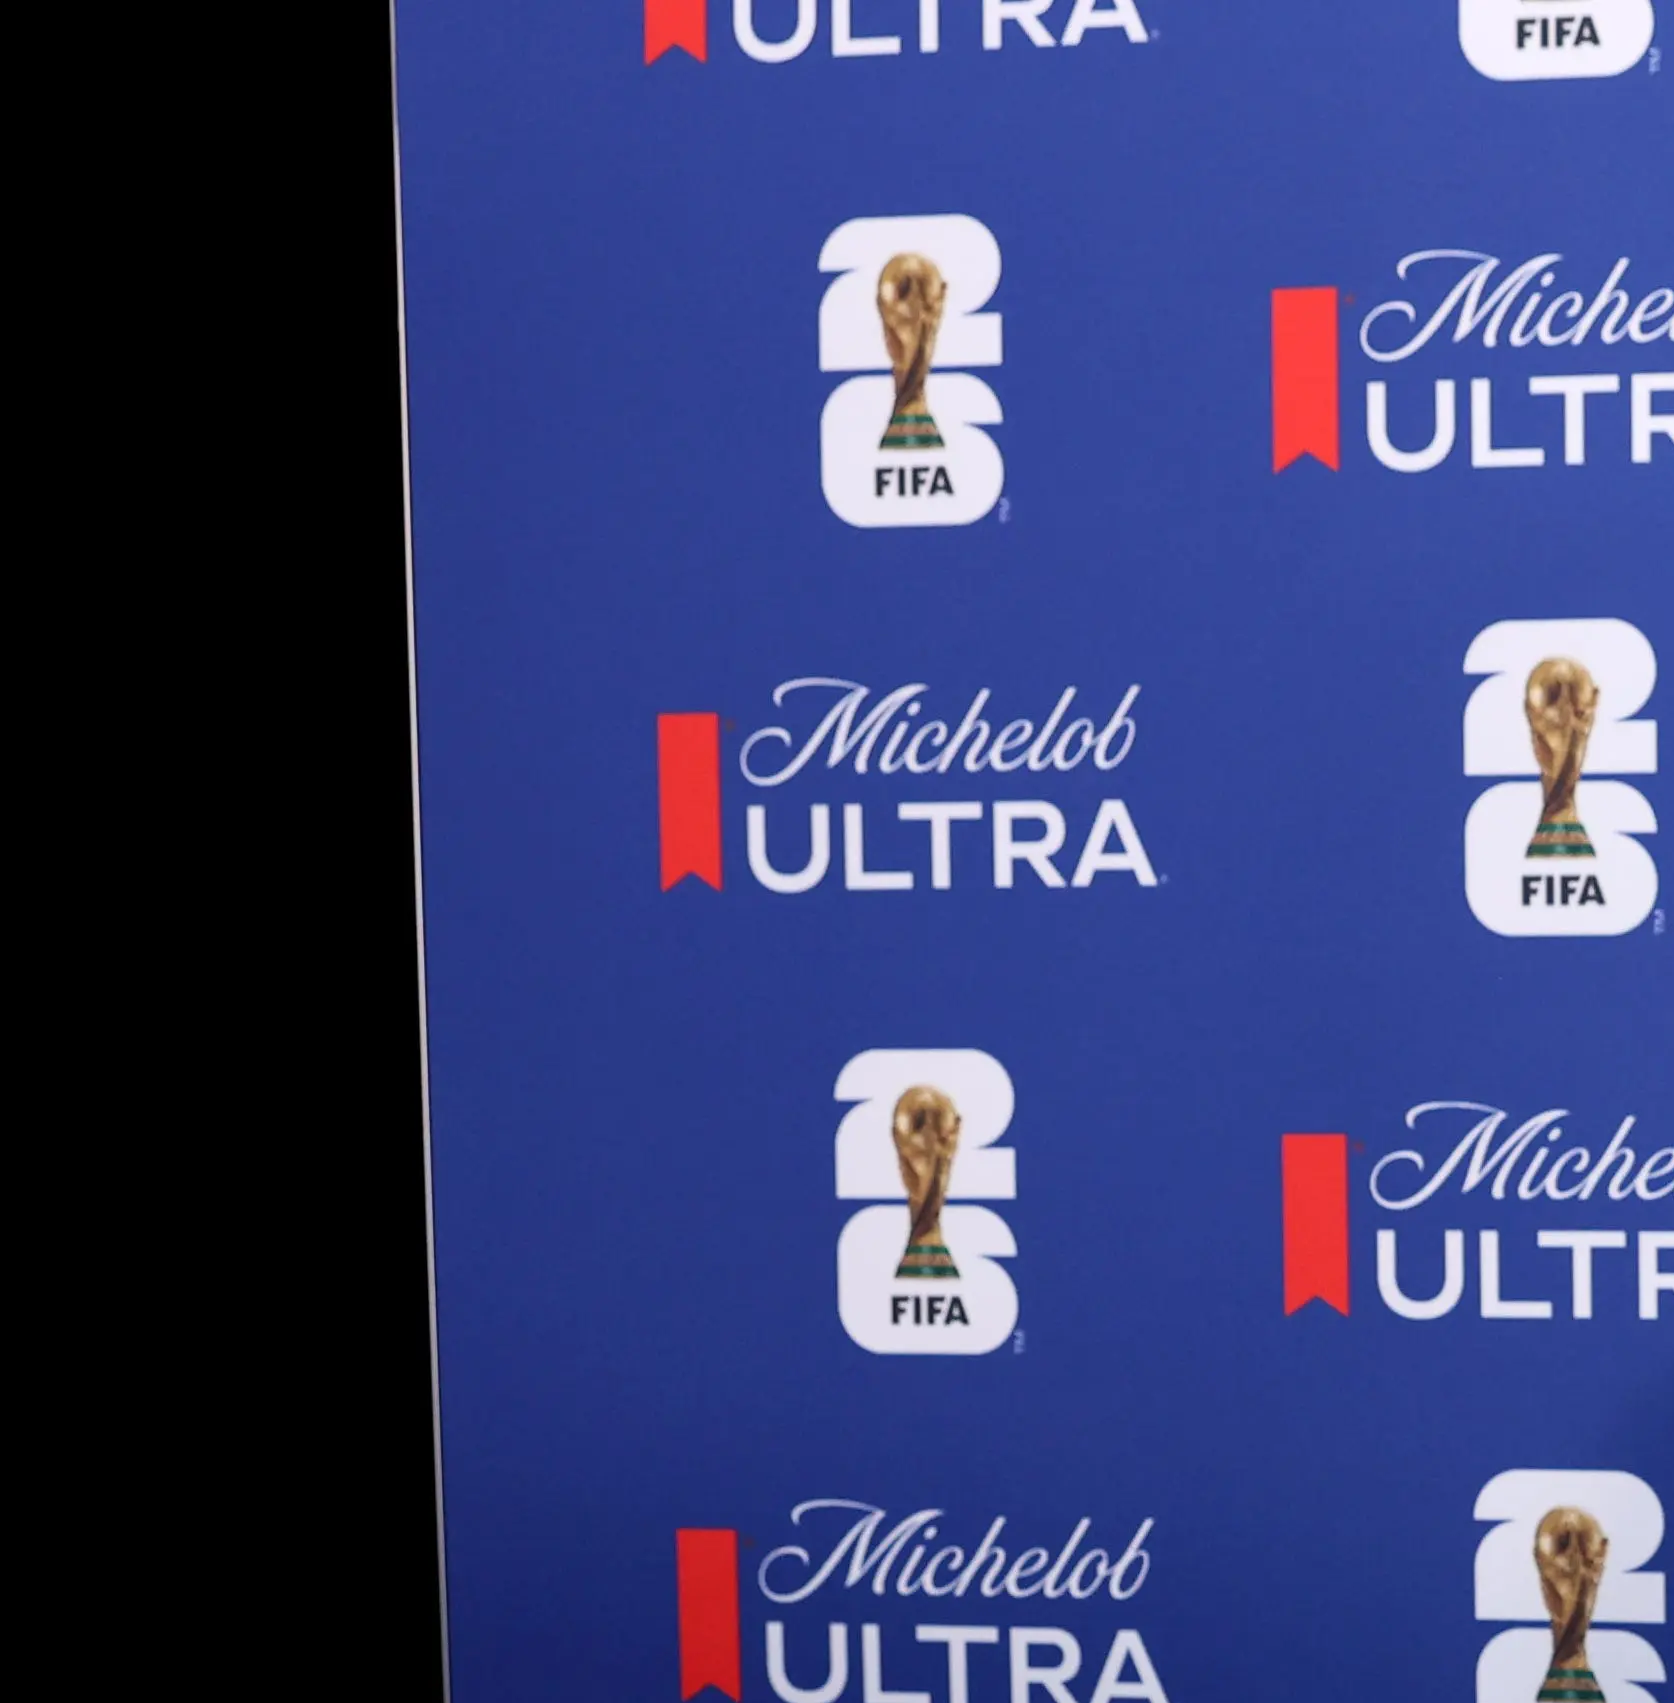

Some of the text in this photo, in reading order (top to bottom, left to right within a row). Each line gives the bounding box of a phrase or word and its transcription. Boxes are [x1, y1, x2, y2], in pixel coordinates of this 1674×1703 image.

[1517, 17, 1600, 48] FIFA
[875, 466, 953, 497] FIFA
[740, 678, 1141, 786] Michelob
[747, 799, 1158, 893] ULTRA
[1522, 875, 1605, 906] FIFA
[891, 1296, 969, 1325] FIFA
[760, 1500, 1153, 1602] Michelob
